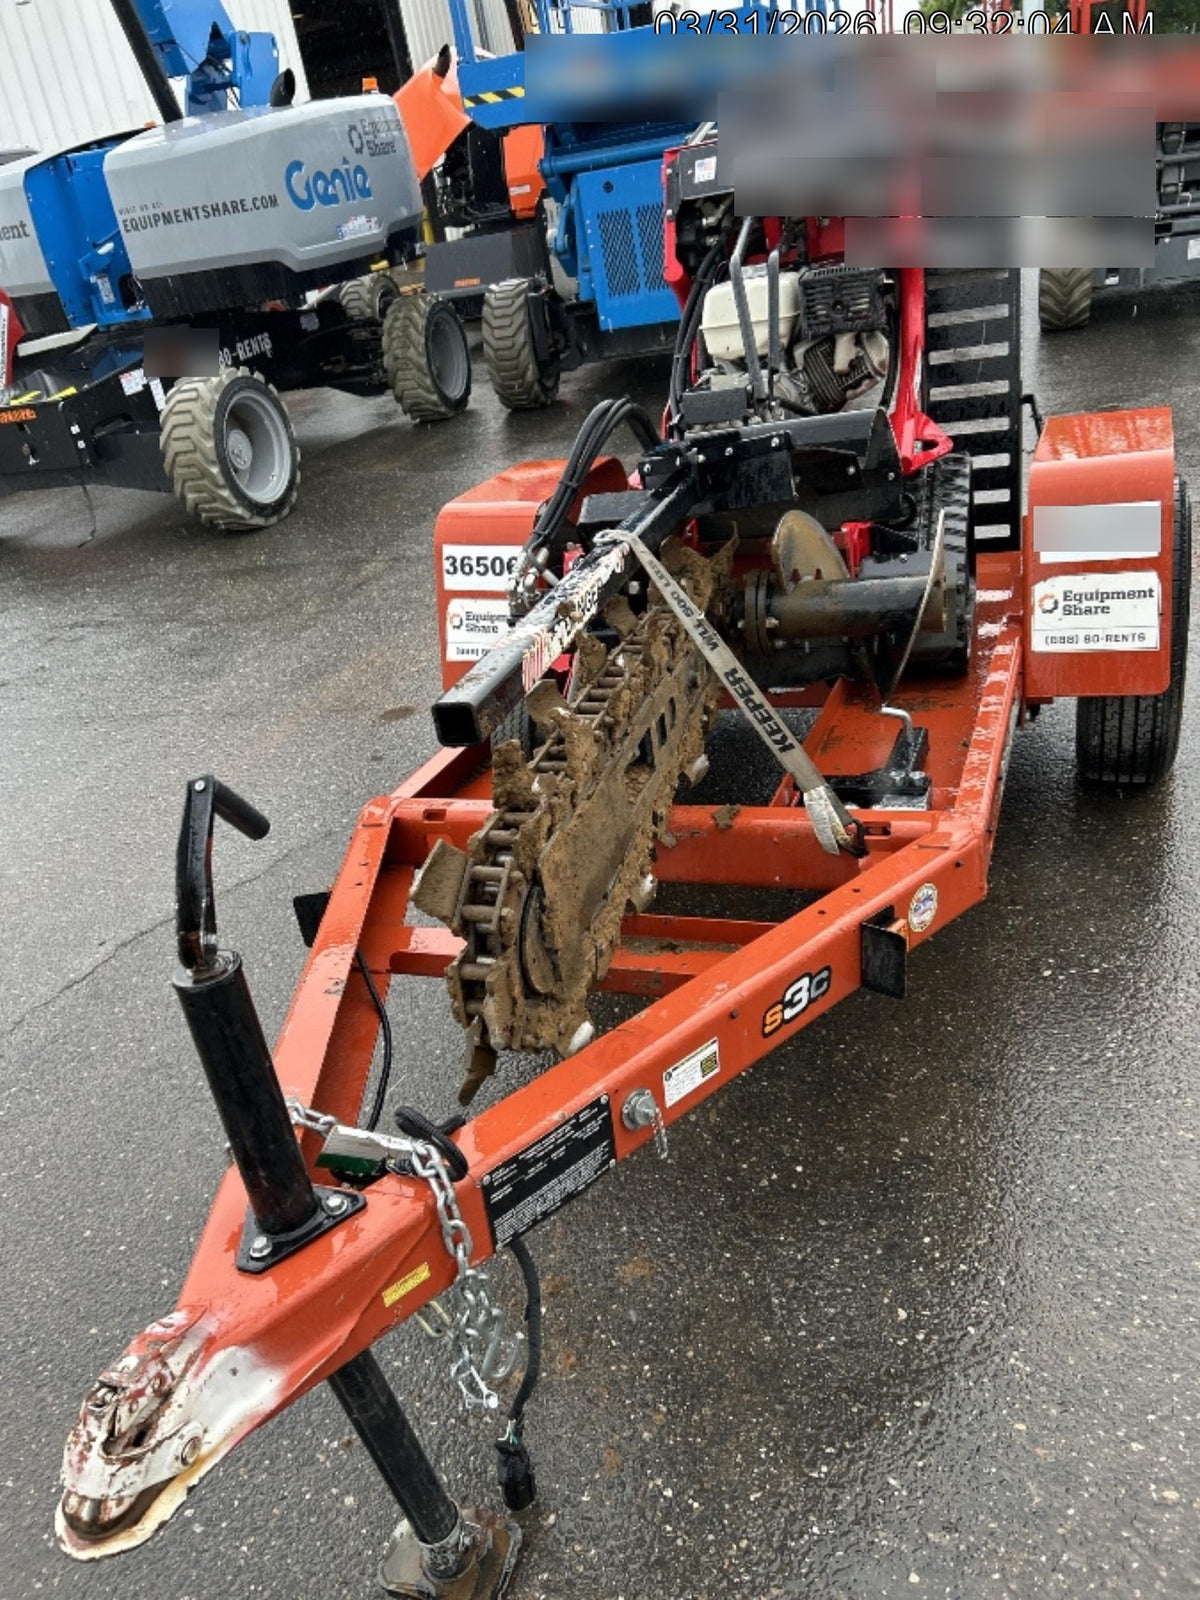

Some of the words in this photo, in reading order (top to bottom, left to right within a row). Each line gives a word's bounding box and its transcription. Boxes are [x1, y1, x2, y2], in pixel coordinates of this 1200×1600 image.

[285, 155, 374, 212] Genie
[122, 193, 280, 233] EQUIPMENTSHARE.COM
[0, 220, 30, 240] ent
[1062, 587, 1155, 603] Equipment
[1062, 604, 1111, 616] Share
[724, 667, 795, 753] KEEPER
